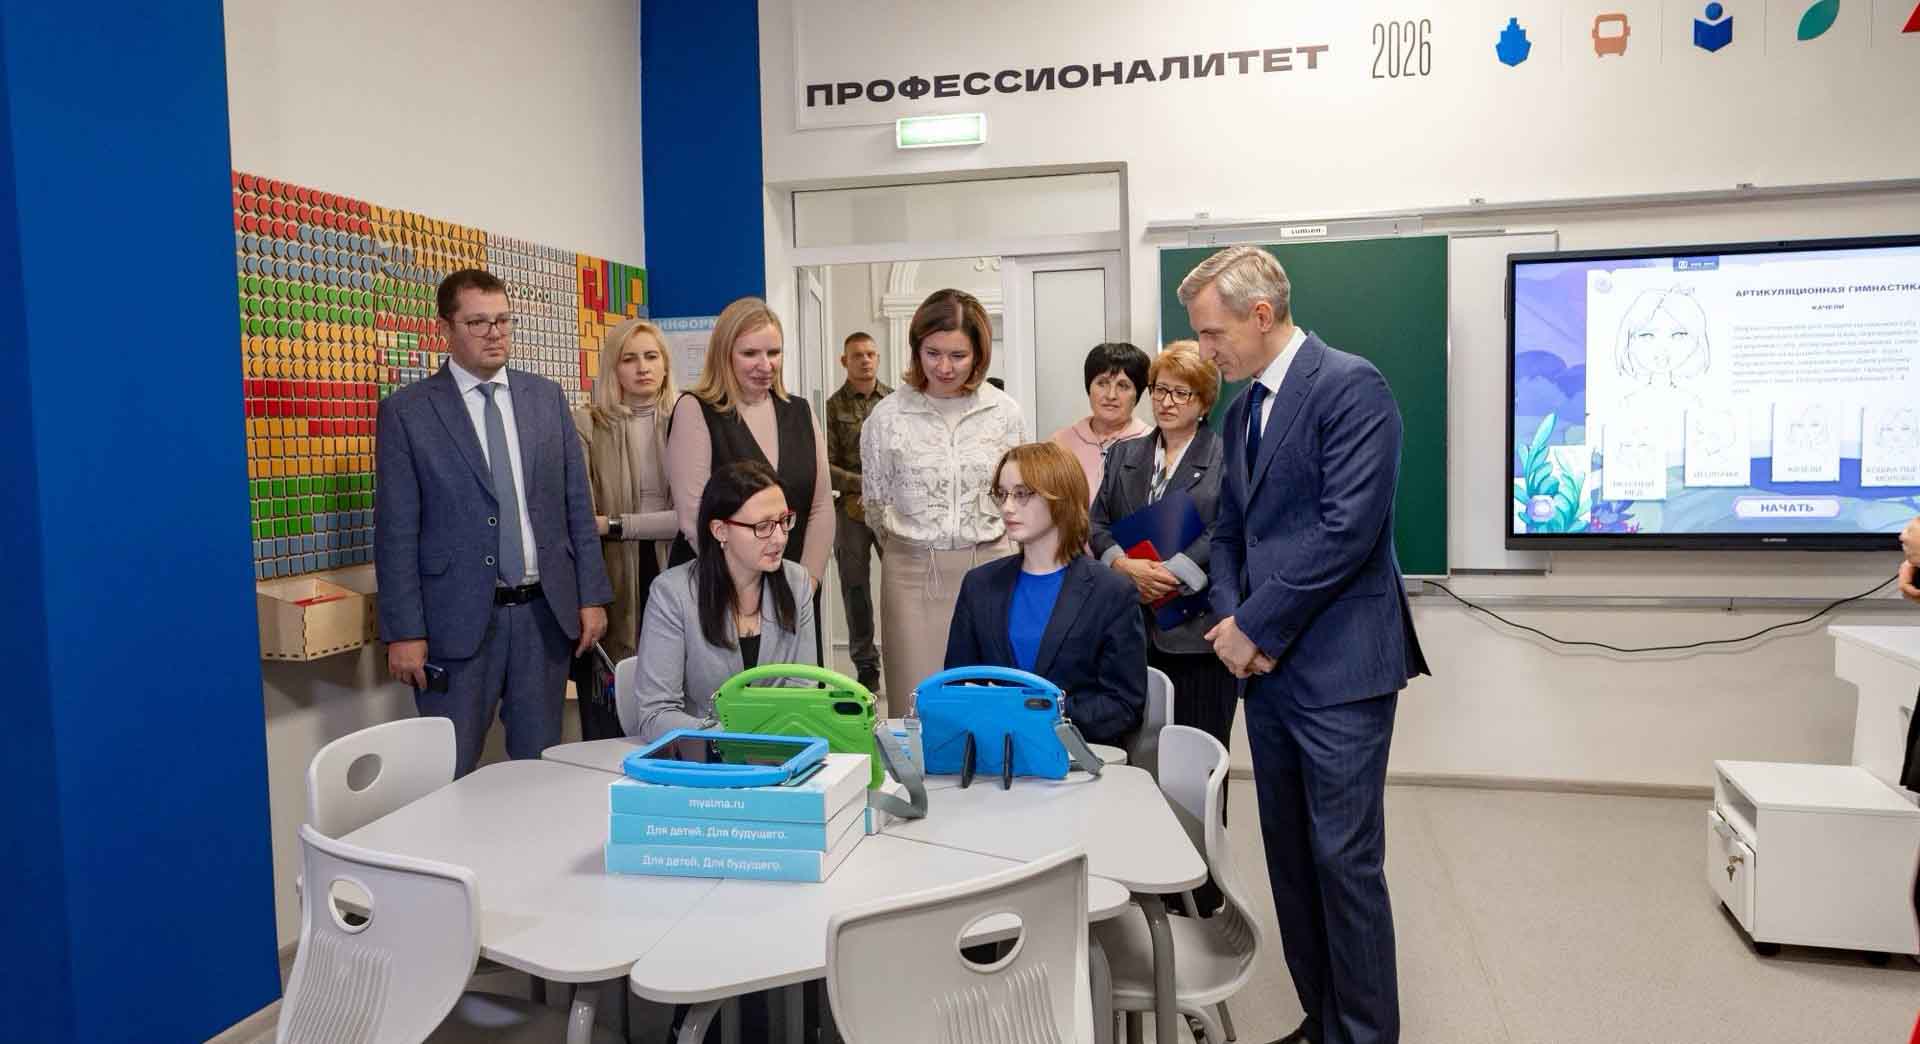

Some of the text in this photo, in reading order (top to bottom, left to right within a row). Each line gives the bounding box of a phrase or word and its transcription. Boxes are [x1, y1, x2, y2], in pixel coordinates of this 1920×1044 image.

[806, 18, 1432, 108] ПРОФЕССИОНАЛИТЕТ 2026
[1735, 286, 1845, 297] АРТИКУЛЯЦИОННАЯ
[658, 319, 719, 332] ИНФОРМ
[1760, 503, 1814, 513] НАЧАТЬ
[646, 824, 787, 840] Для детей. Для будущего.
[642, 855, 664, 866] Для
[665, 856, 701, 868] детей.
[703, 857, 725, 869] Для
